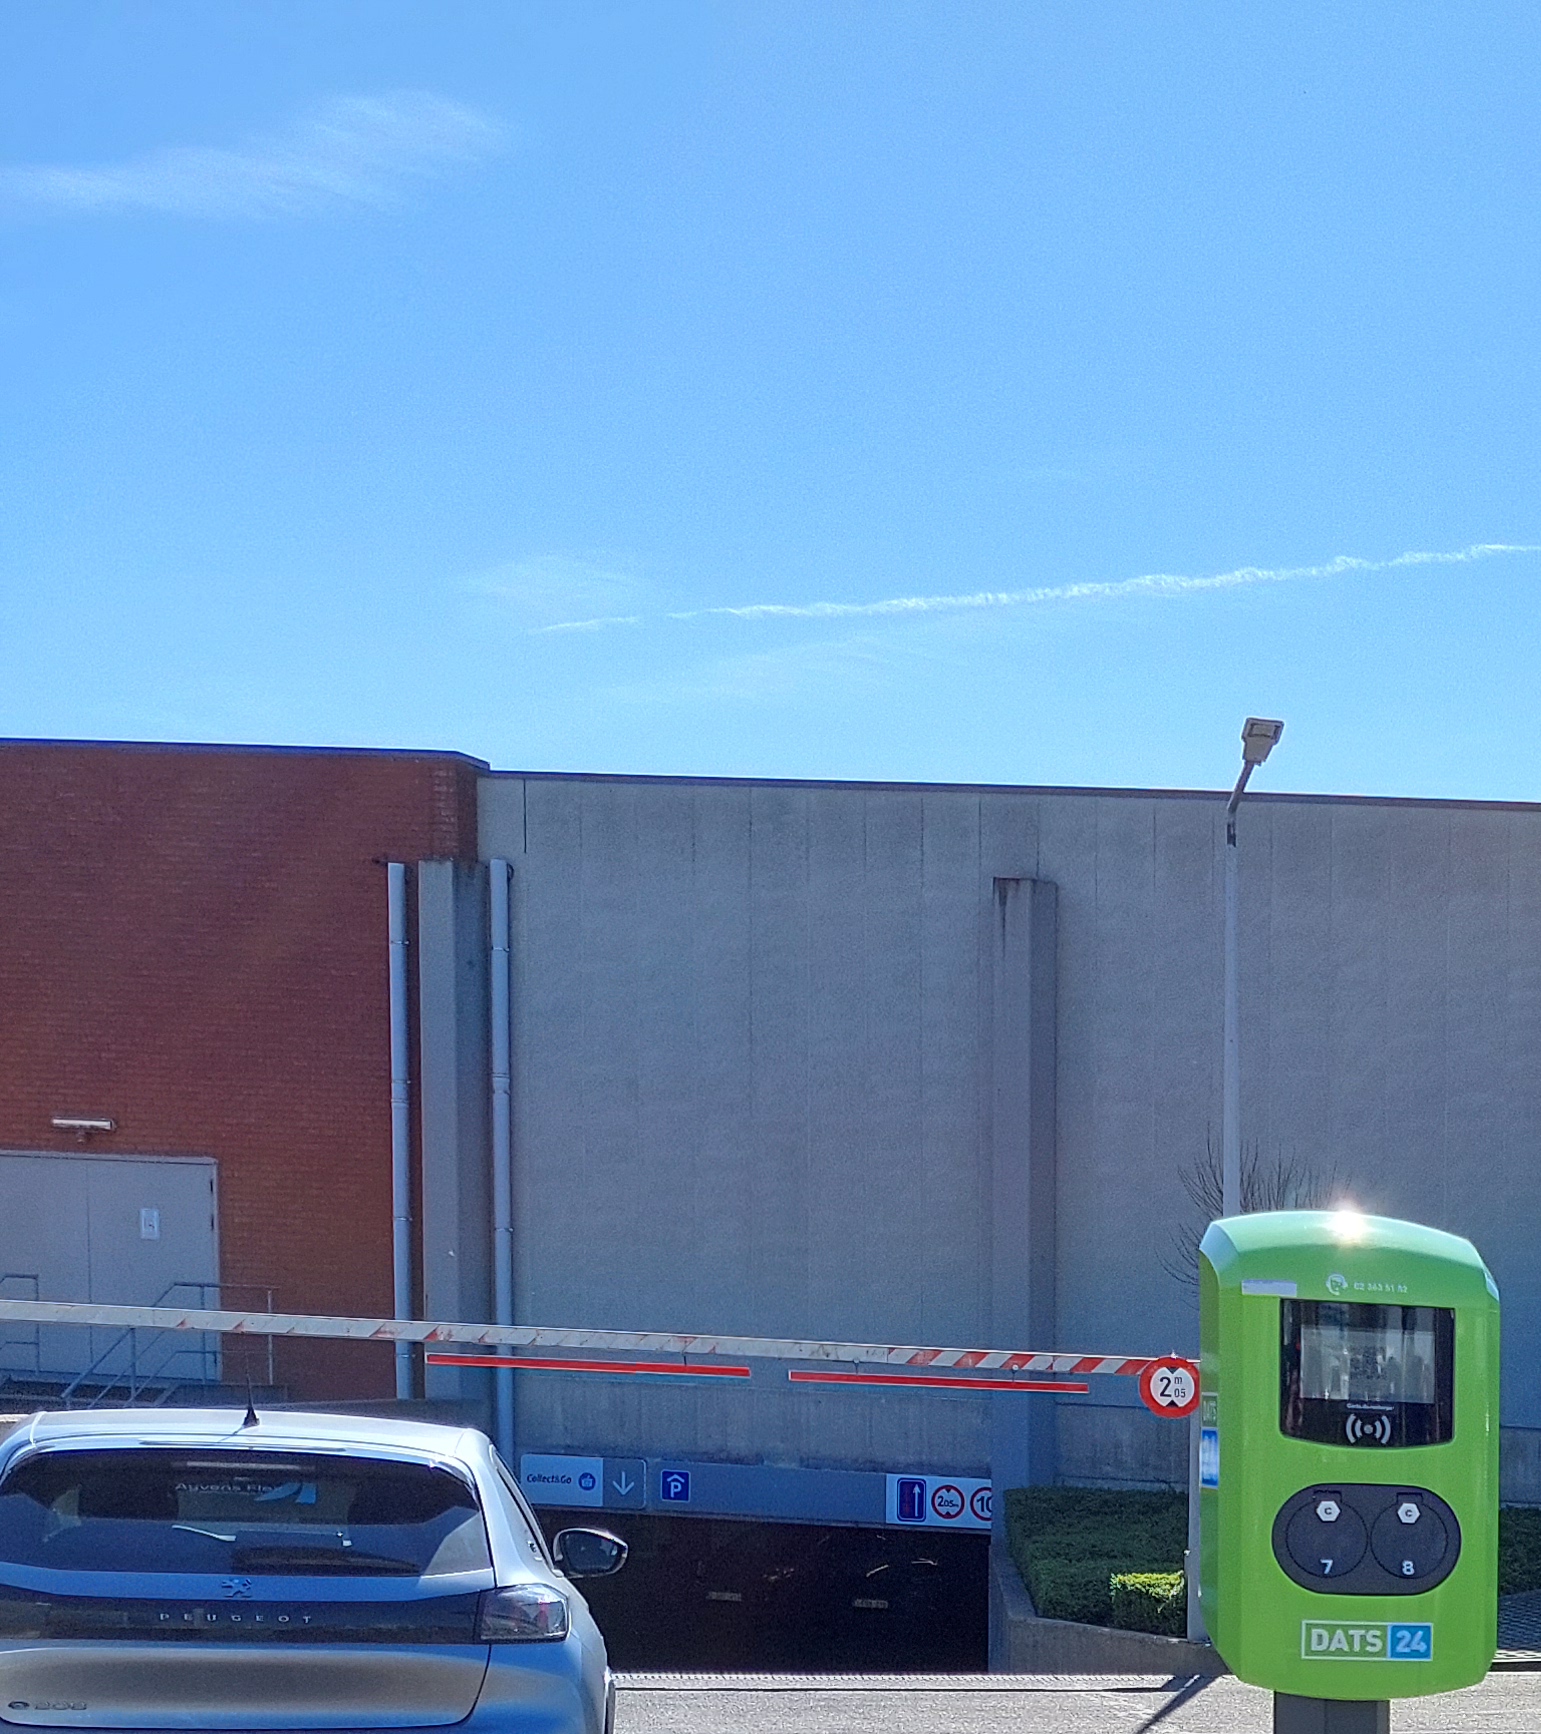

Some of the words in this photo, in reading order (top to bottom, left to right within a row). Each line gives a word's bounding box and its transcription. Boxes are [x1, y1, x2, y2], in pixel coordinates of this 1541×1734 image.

[1159, 1376, 1172, 1398] 2
[1174, 1388, 1186, 1399] 05
[670, 1481, 682, 1498] P
[1320, 1559, 1334, 1575] 7
[1402, 1560, 1415, 1576] 8
[159, 1612, 312, 1625] PEUGEOT
[1310, 1628, 1383, 1653] DATS
[1395, 1630, 1428, 1654] 24
